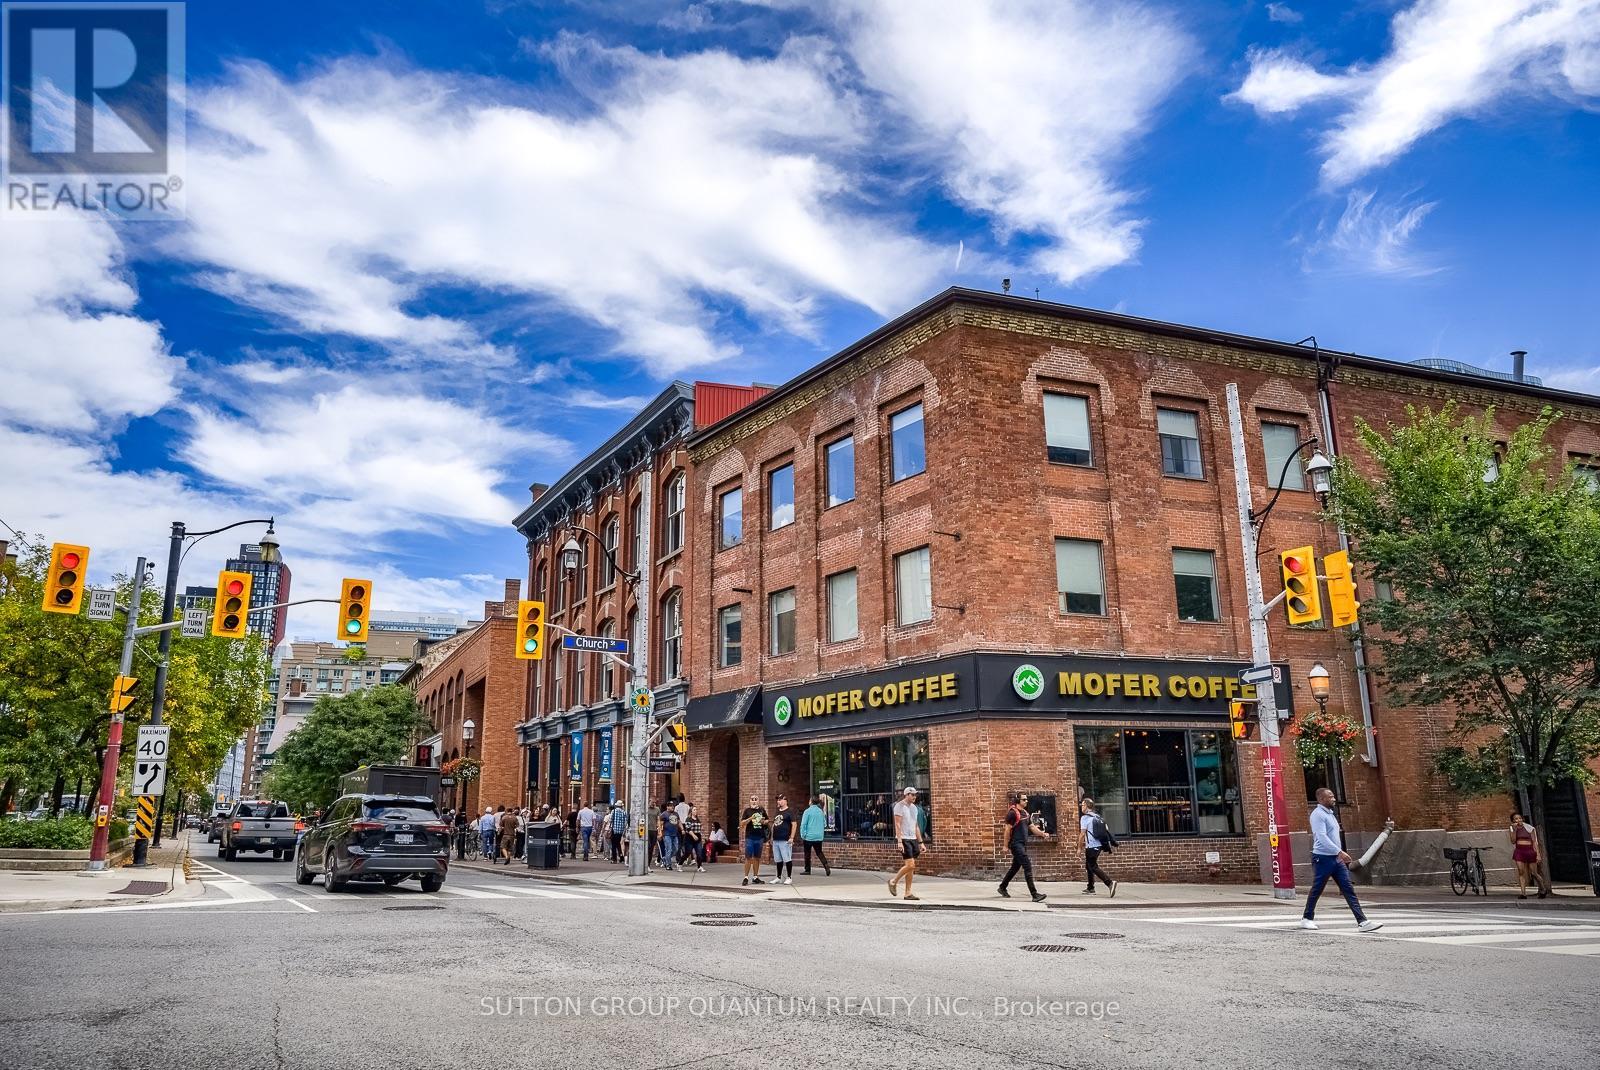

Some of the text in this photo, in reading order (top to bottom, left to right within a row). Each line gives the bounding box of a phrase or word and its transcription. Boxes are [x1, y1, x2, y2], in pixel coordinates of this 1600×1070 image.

[90, 609, 112, 617] SIGNAL
[575, 637, 608, 649] Church
[1058, 672, 1161, 697] MOFER
[1168, 674, 1257, 699] COFFE
[798, 689, 865, 718] MOFER
[868, 673, 958, 708] COFFEE
[139, 740, 165, 756] 40
[1272, 861, 1281, 884] OLD
